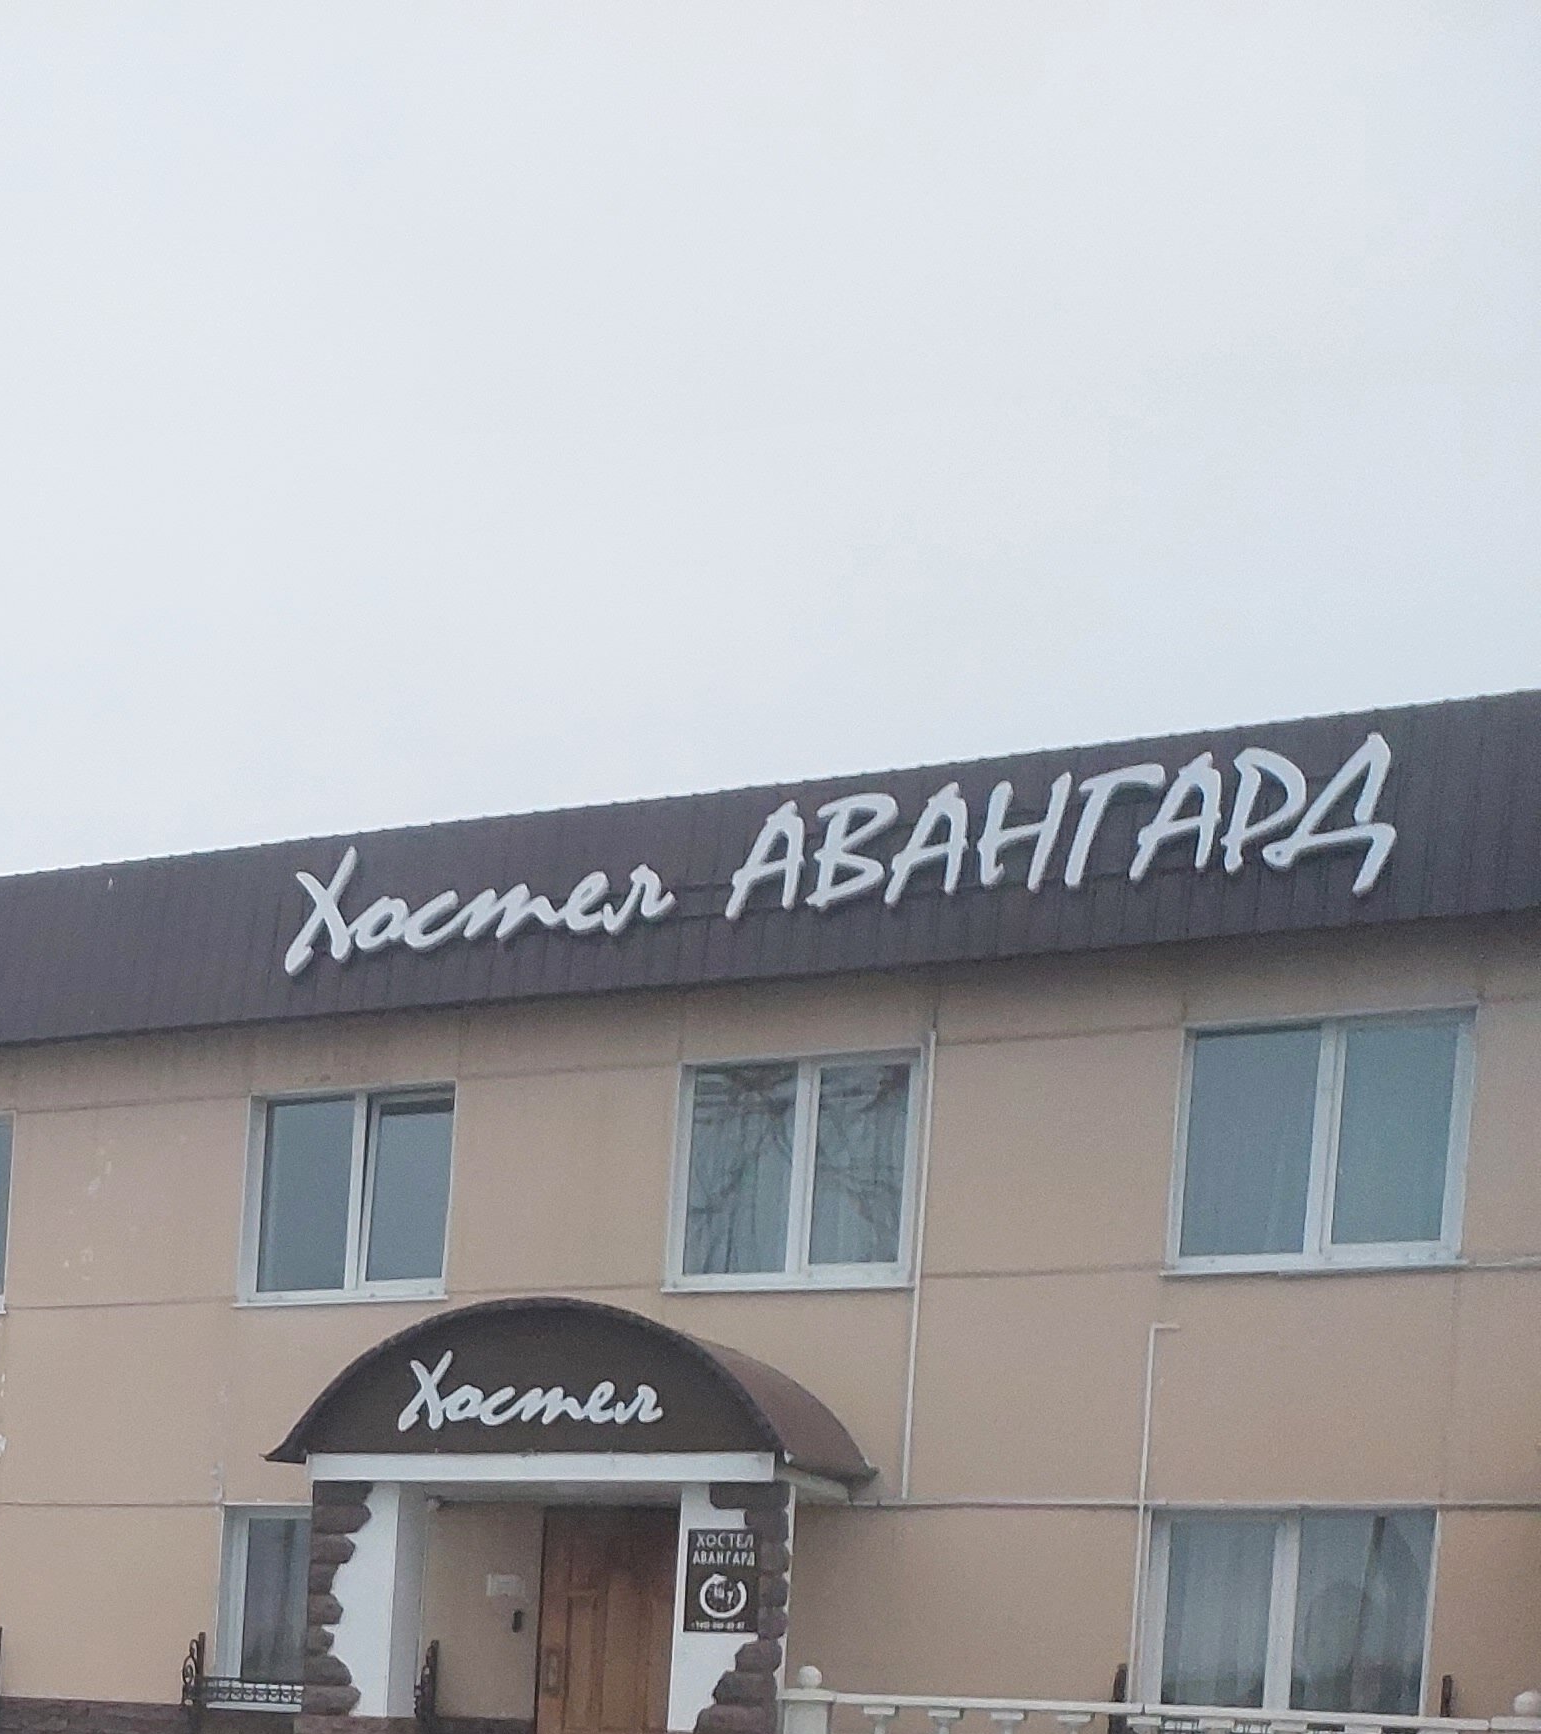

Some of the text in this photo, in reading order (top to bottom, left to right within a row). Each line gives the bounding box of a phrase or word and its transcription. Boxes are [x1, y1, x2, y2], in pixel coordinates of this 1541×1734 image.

[284, 731, 1398, 977] Хостел АВАНГАРД
[397, 1349, 665, 1432] Хостел
[692, 1550, 756, 1567] АВАНГАРД
[696, 1532, 755, 1549] ХОСТЕЛ
